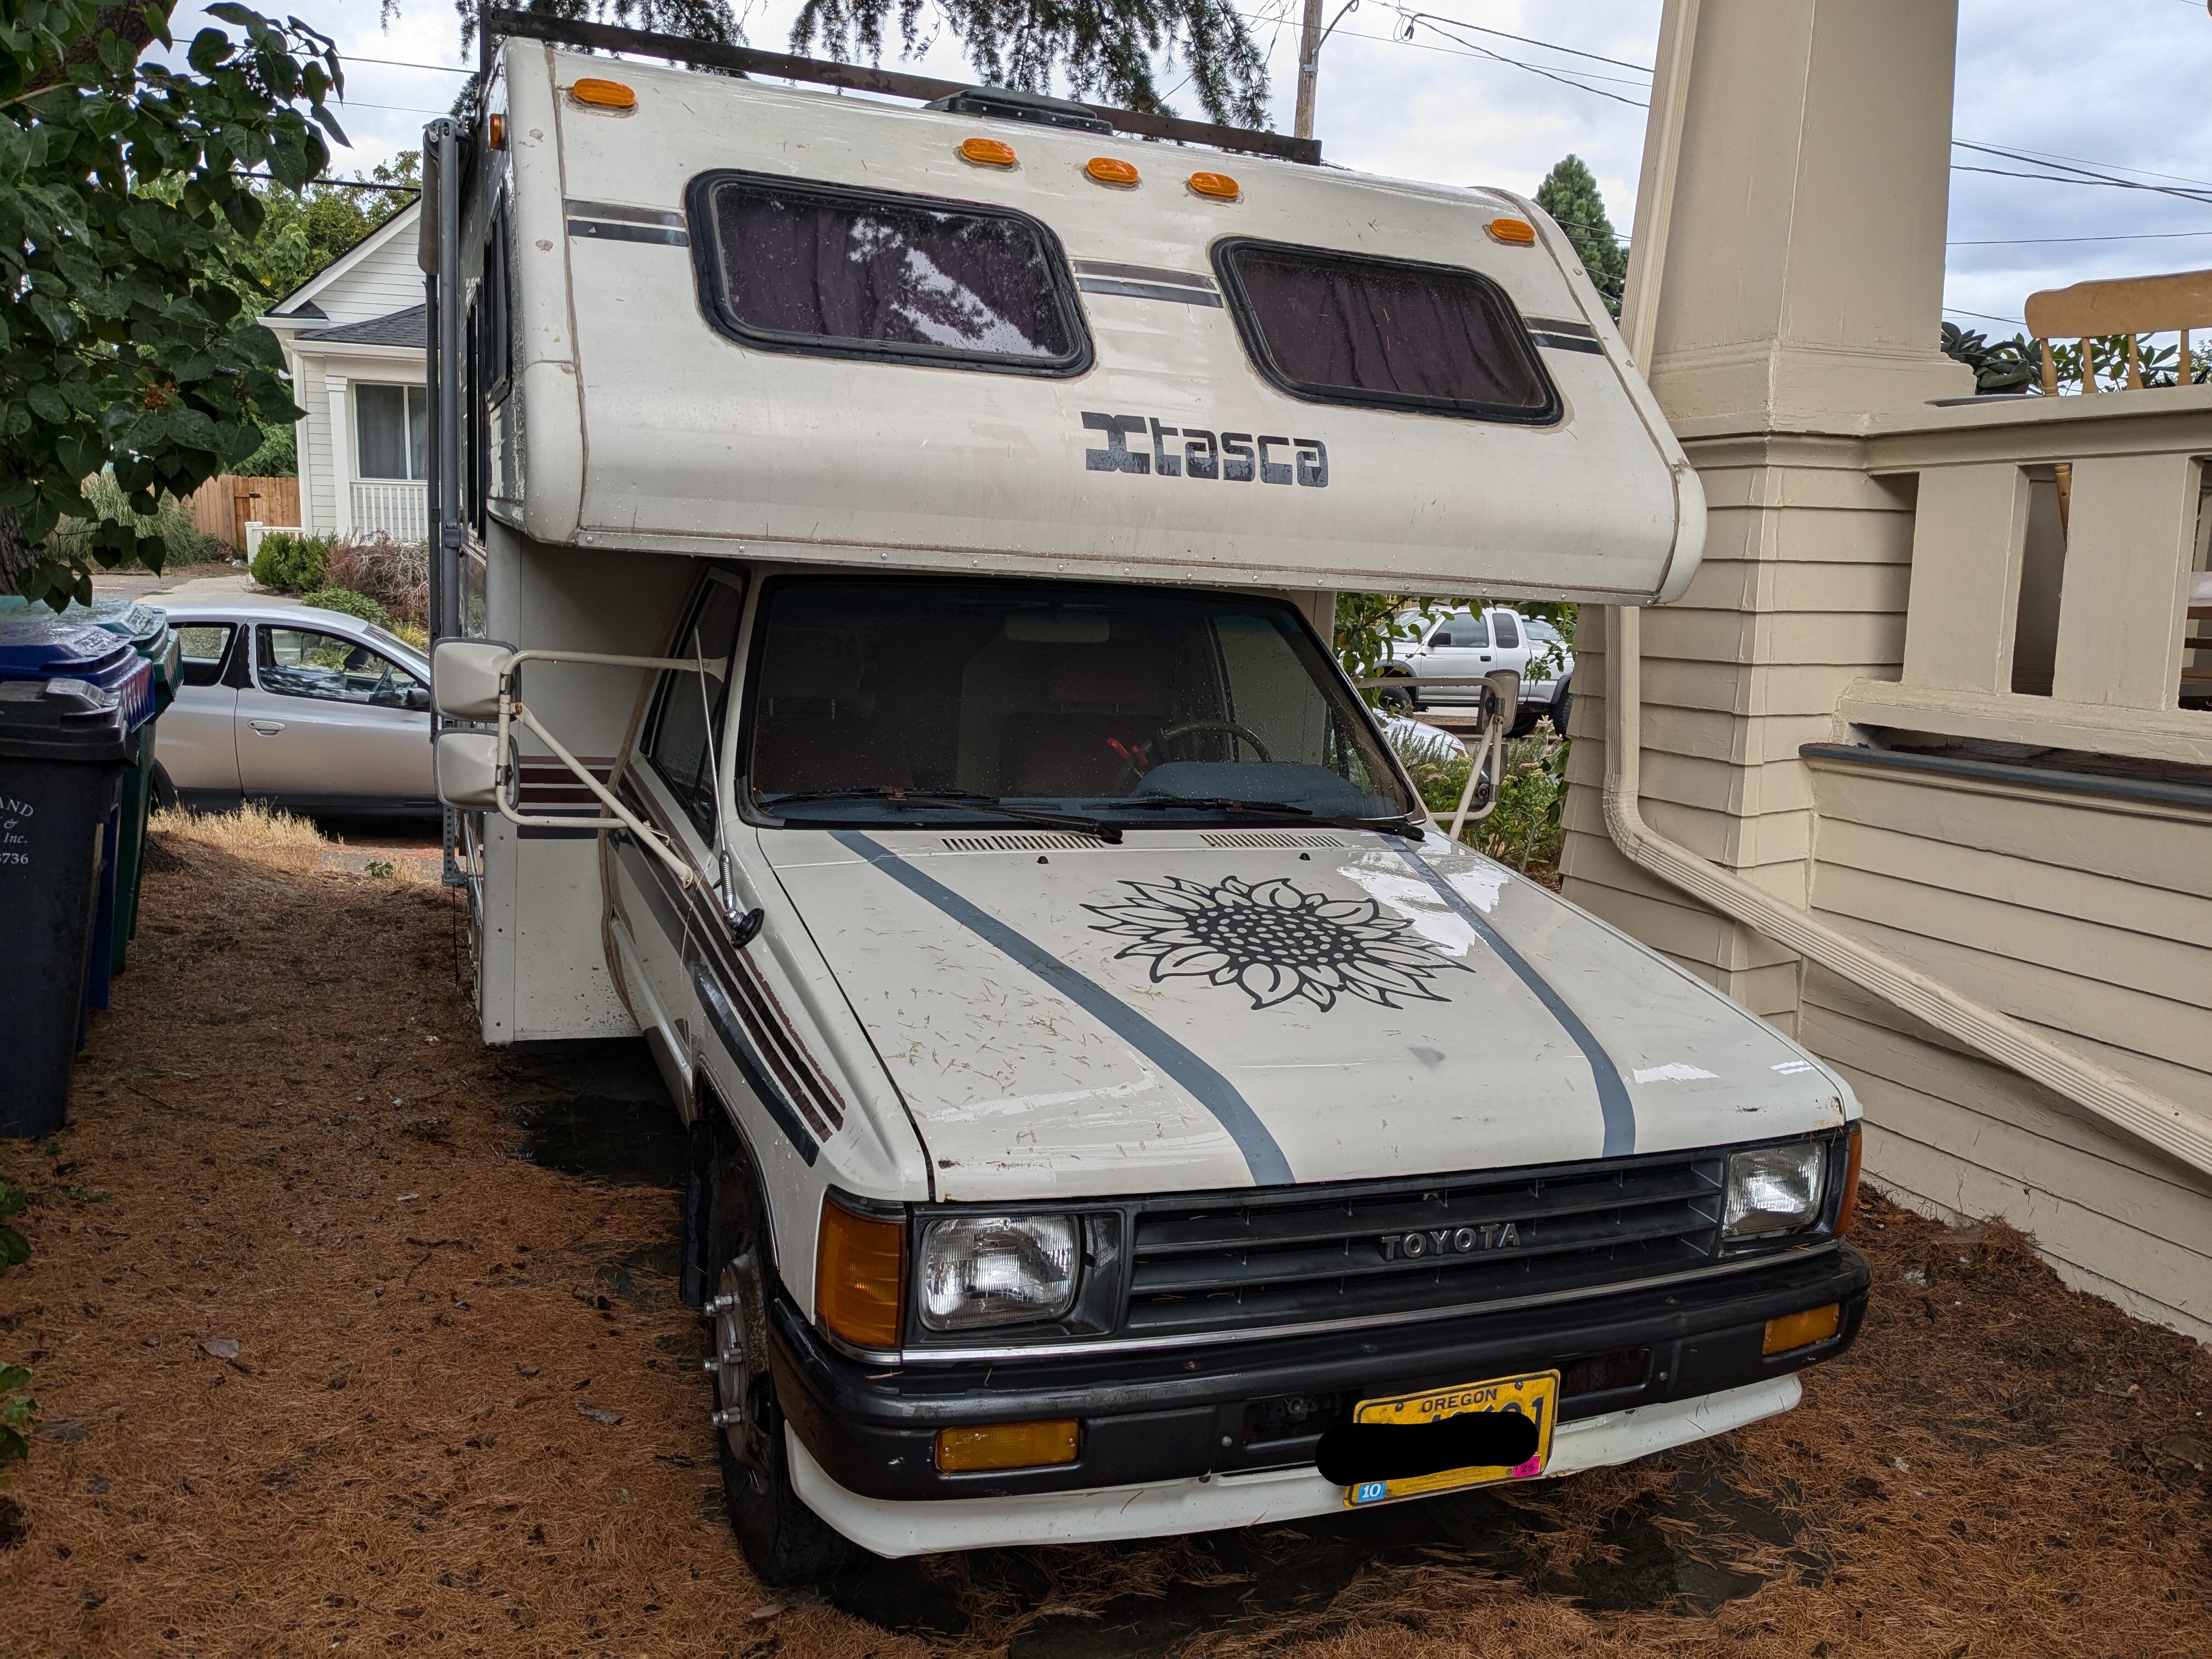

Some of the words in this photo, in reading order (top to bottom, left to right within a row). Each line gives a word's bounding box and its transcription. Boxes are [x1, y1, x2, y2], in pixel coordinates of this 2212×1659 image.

[1081, 411, 1328, 488] Itasca
[3, 833, 27, 843] Inc.
[0, 853, 29, 864] 736
[1380, 1223, 1521, 1260] TOYOTA
[1421, 1389, 1498, 1413] OREGON
[1520, 1463, 1534, 1474] 25
[1362, 1483, 1381, 1498] 10
